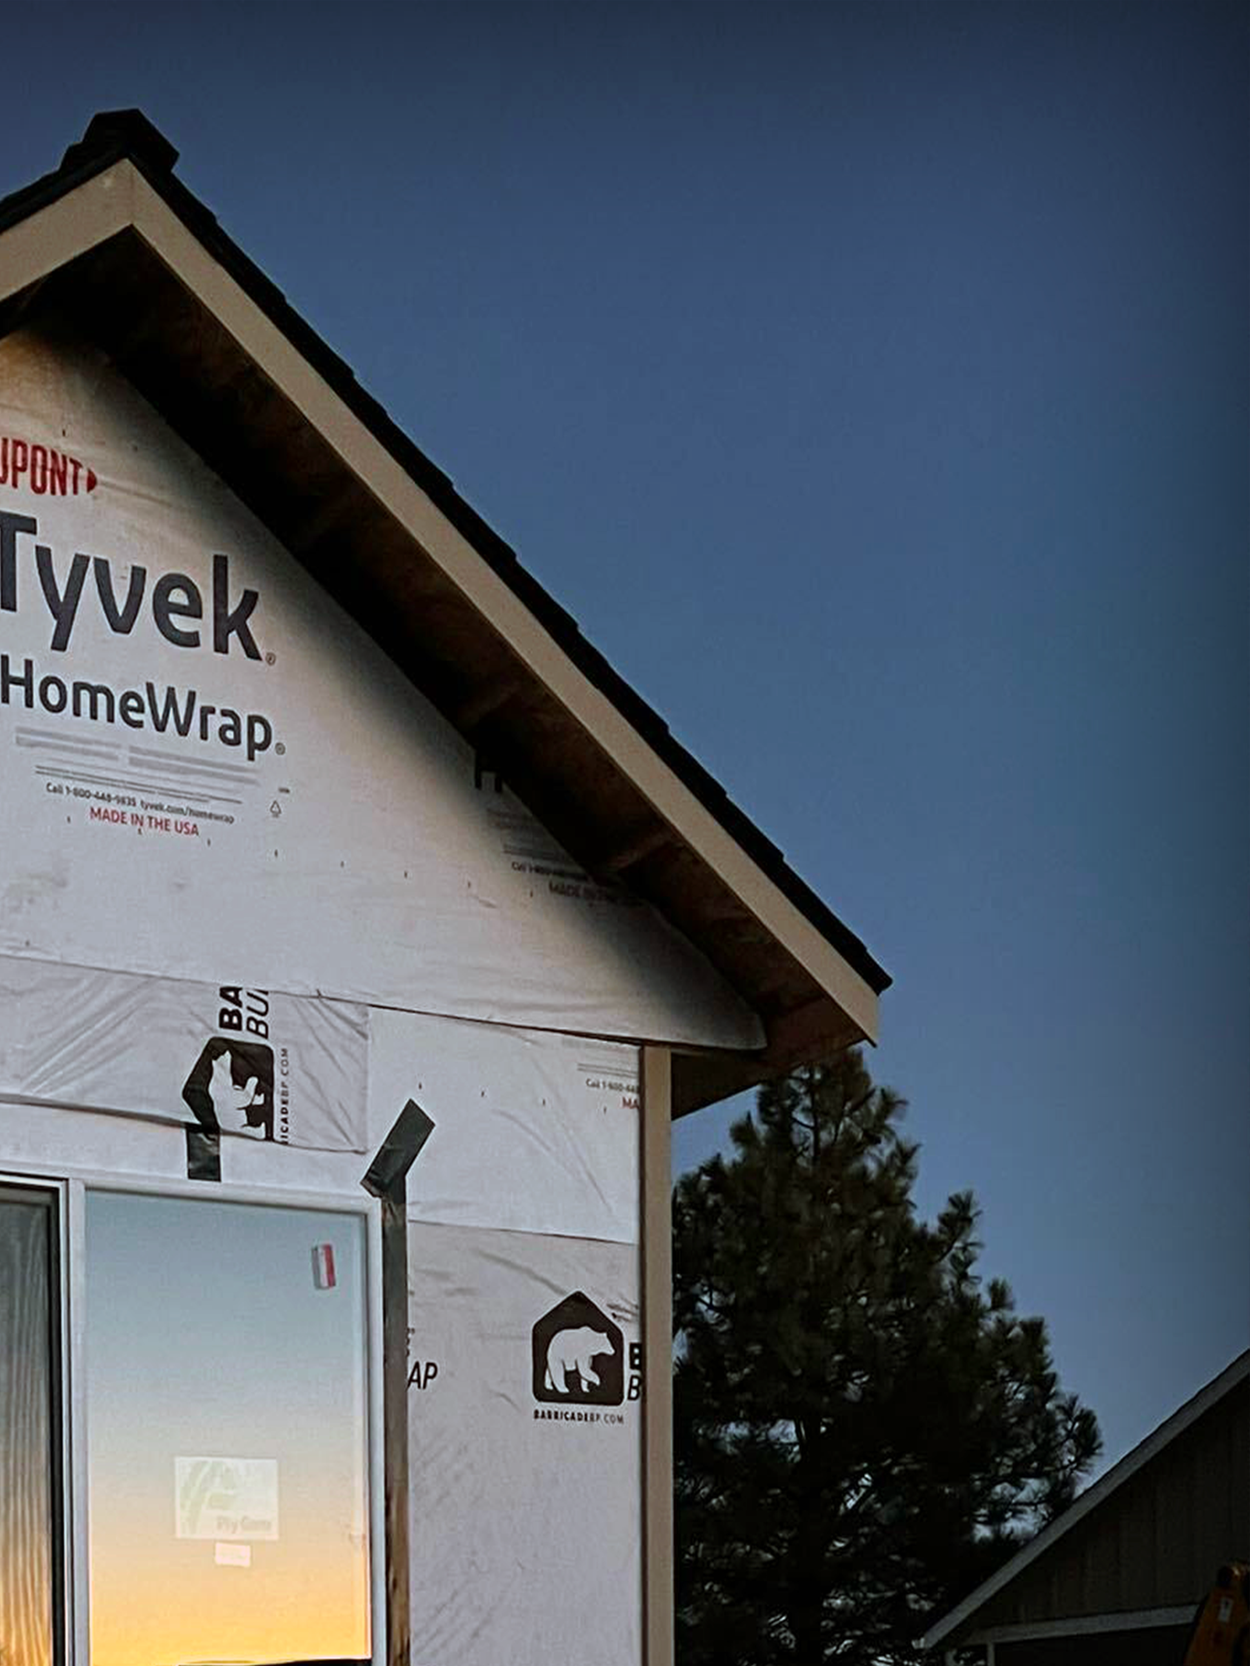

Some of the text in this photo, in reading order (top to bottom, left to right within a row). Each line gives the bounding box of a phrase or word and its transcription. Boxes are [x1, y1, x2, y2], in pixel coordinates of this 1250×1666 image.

[0, 654, 272, 761] HomeWrap
[90, 807, 200, 837] MADE IN THE USA
